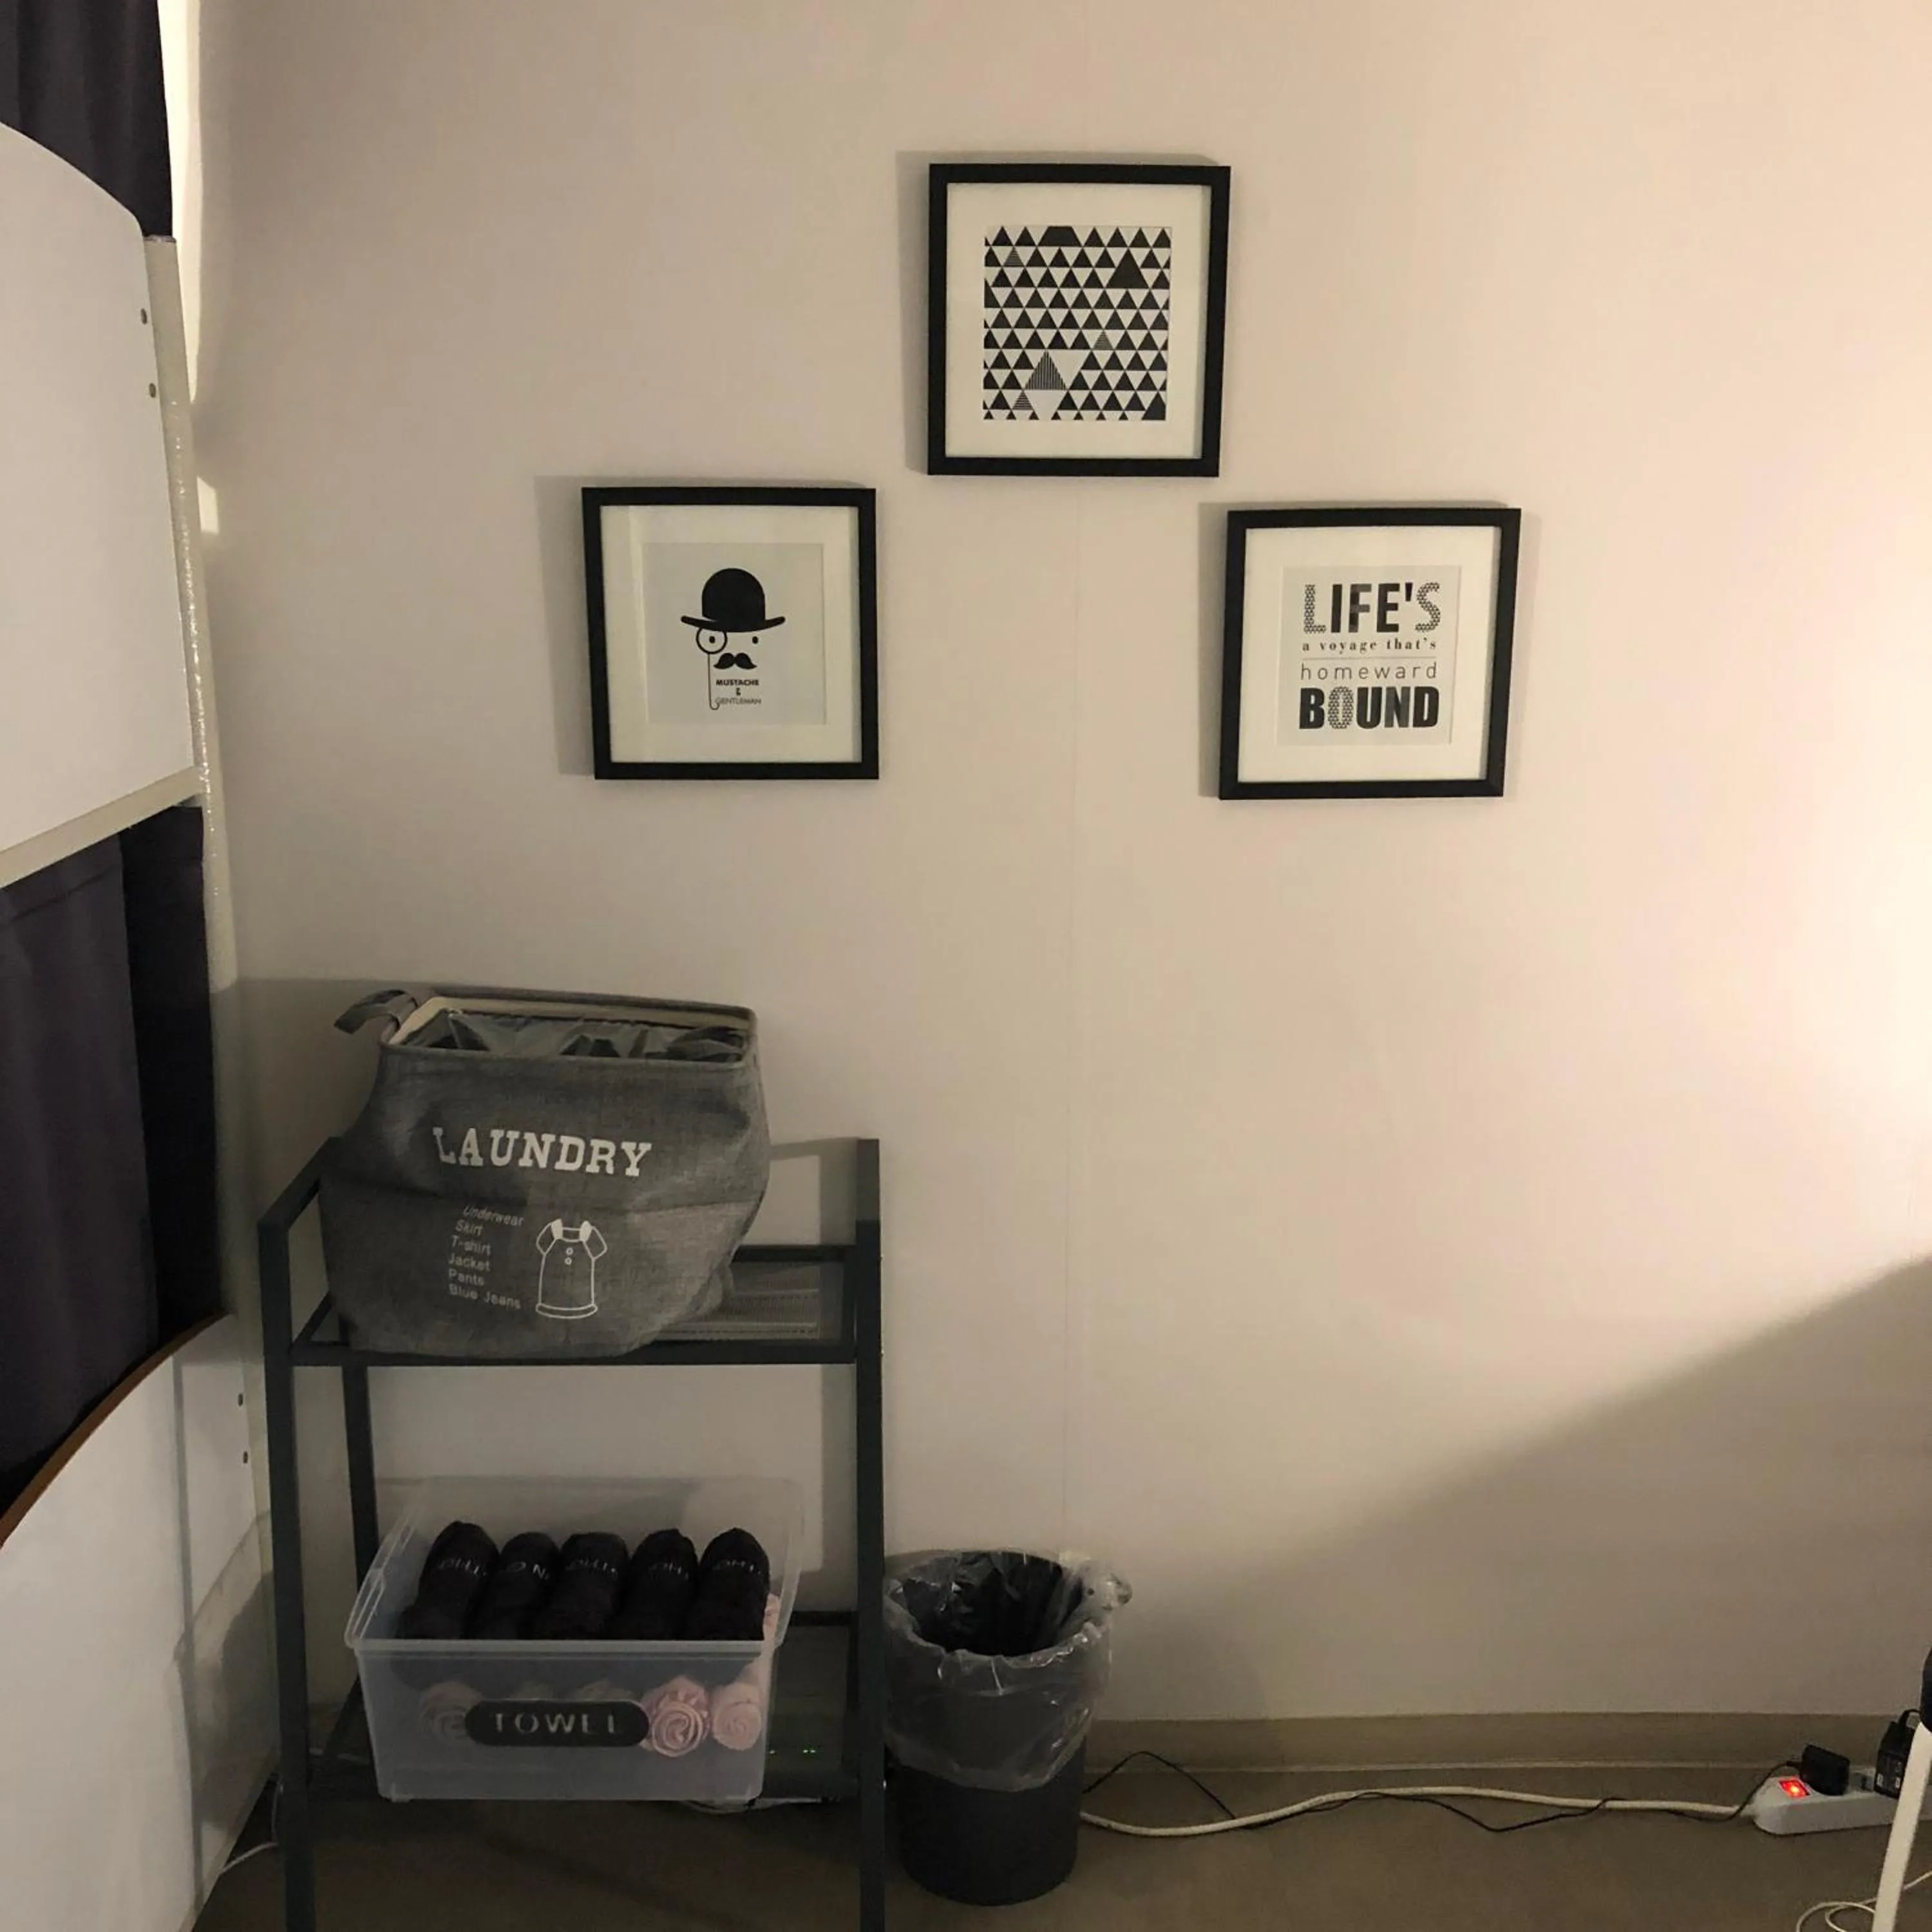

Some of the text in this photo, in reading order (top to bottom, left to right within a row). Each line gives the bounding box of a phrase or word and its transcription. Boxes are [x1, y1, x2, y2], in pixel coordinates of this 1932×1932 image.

[1303, 582, 1441, 634] LIFE'S
[1302, 637, 1437, 654] a voyage that's
[1300, 661, 1437, 680] homeward
[1299, 686, 1440, 729] BOUND
[432, 1127, 652, 1177] LAUNDRY
[463, 1205, 524, 1227] Underwear
[452, 1235, 491, 1256] T-shirt
[448, 1253, 491, 1272] Jacket
[448, 1268, 484, 1287] Pants
[449, 1283, 521, 1309] Blue Jeans
